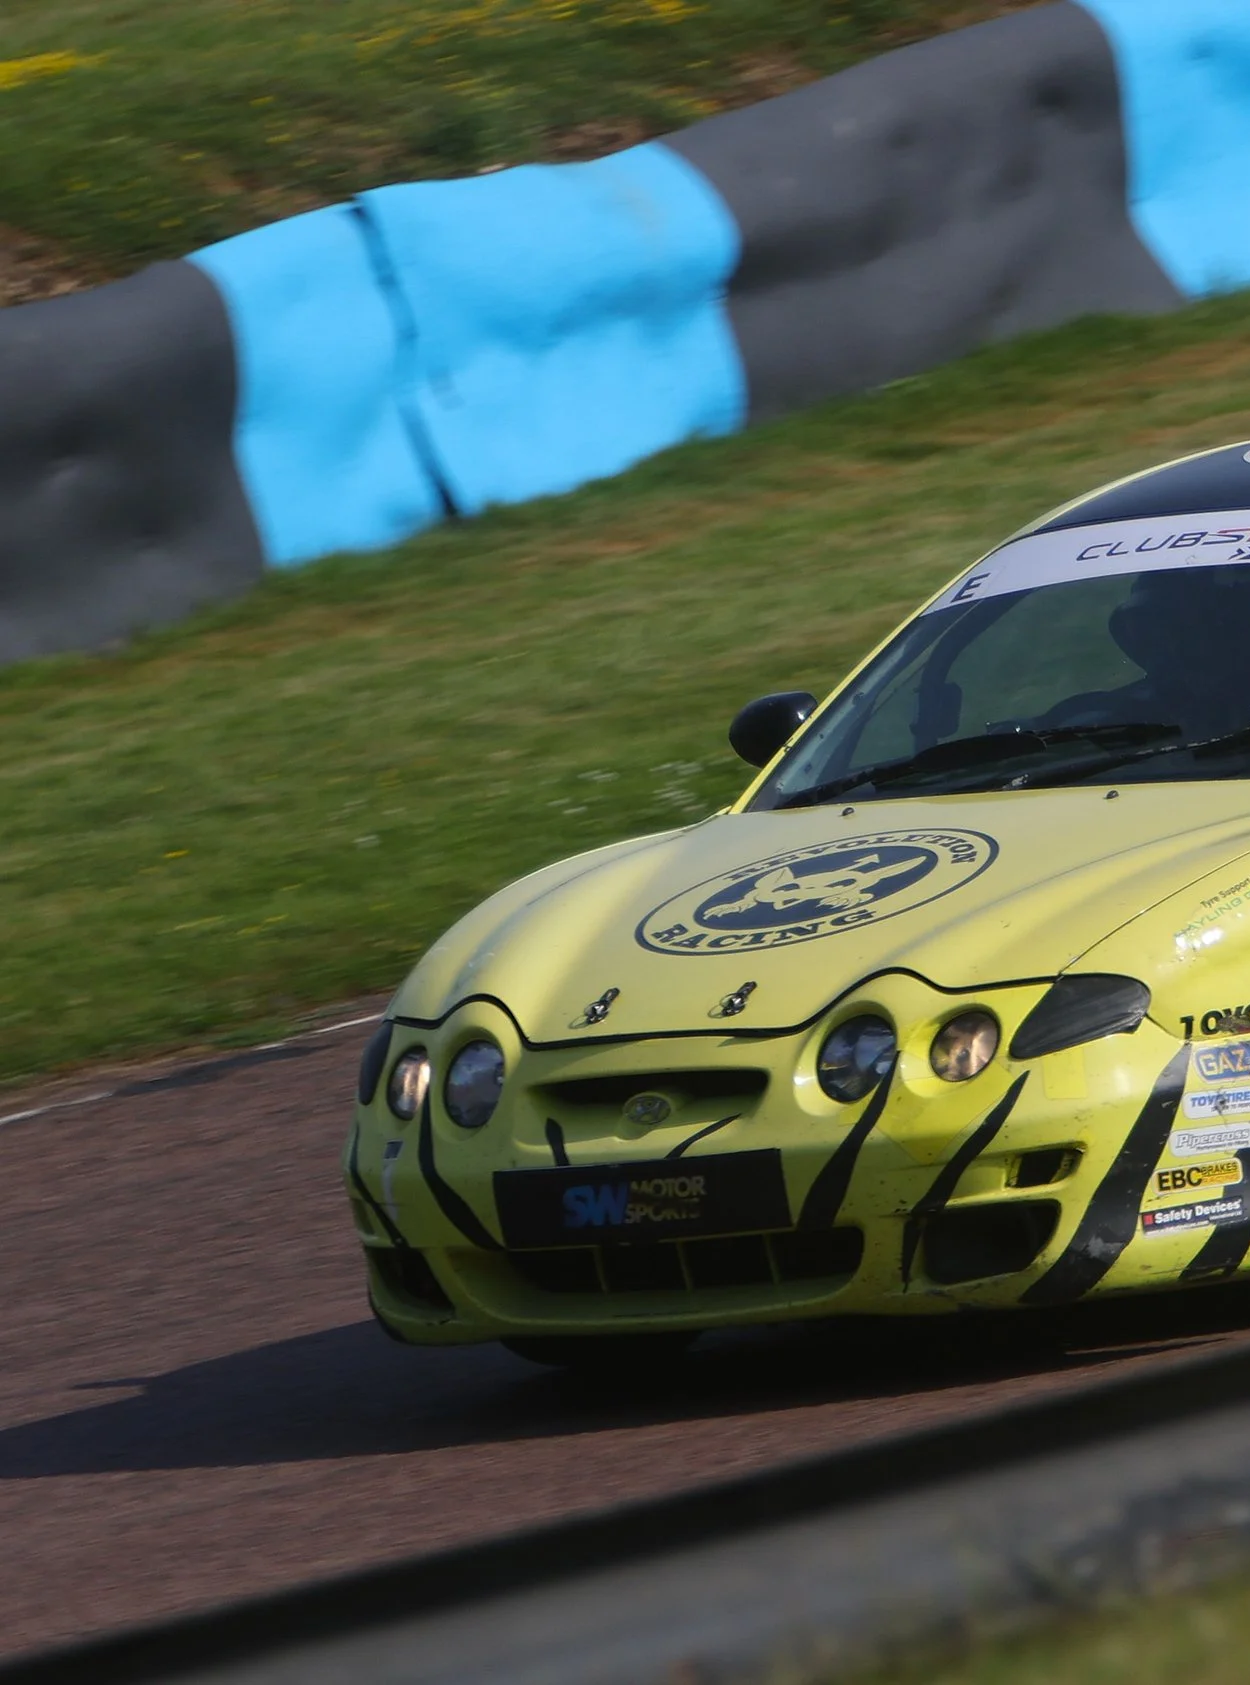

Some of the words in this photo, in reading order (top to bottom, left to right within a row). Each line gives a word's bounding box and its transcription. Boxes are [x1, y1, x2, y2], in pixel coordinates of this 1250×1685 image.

[949, 572, 992, 604] E
[1200, 896, 1220, 909] Tyre
[1219, 877, 1250, 898] Support
[651, 908, 876, 949] RACING
[1199, 1048, 1250, 1077] GAZ
[1176, 1127, 1250, 1150] Pipercross
[630, 1175, 707, 1198] MOTOR
[1157, 1166, 1203, 1192] EBC
[1201, 1161, 1238, 1176] BRAKES
[563, 1183, 628, 1227] SW
[1154, 1207, 1193, 1225] Safety
[1195, 1201, 1241, 1217] Devices
